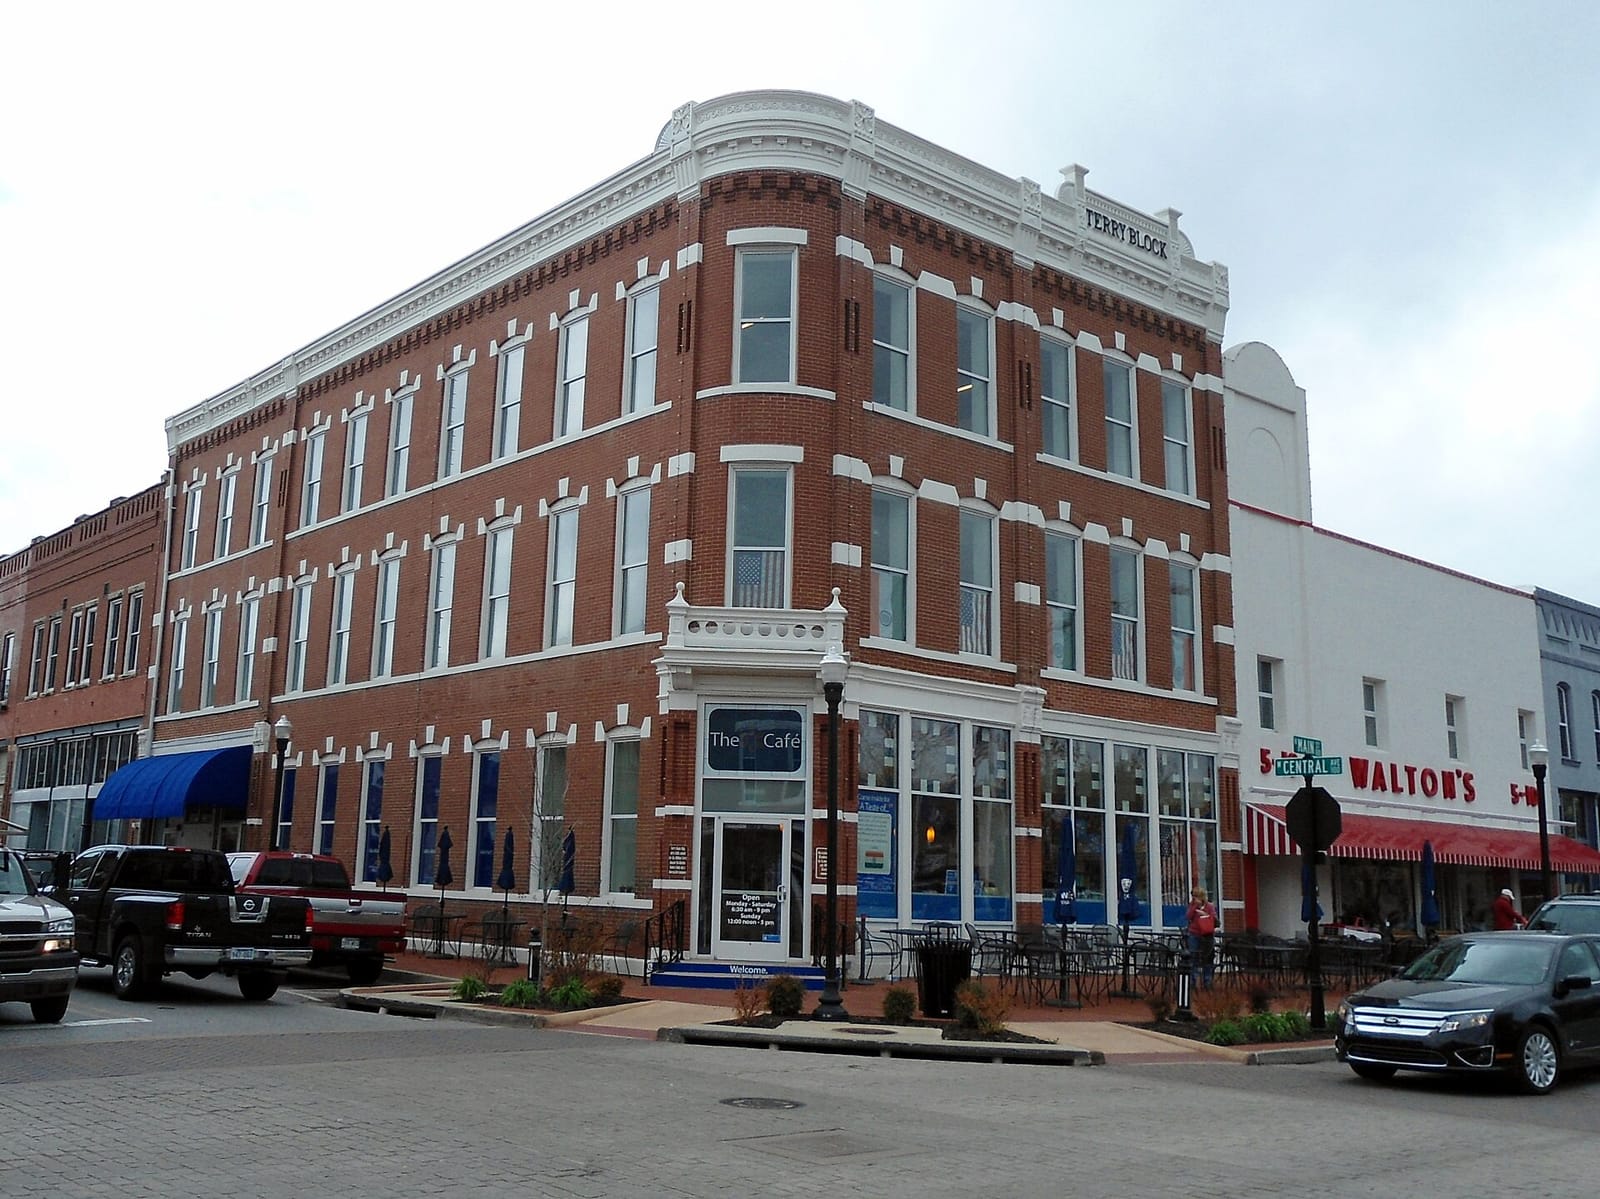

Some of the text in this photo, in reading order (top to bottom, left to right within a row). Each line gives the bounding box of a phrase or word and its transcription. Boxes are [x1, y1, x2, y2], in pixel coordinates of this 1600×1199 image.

[1085, 208, 1168, 260] TERRY BLOCK
[709, 731, 801, 748] The Café
[1297, 739, 1315, 754] MAIN
[1283, 760, 1329, 774] CENTRAL
[1349, 757, 1476, 803] WALTON'S
[742, 894, 760, 902] Open
[752, 901, 776, 910] Saturday
[740, 913, 761, 921] Sunday
[730, 965, 768, 975] Welcome.
